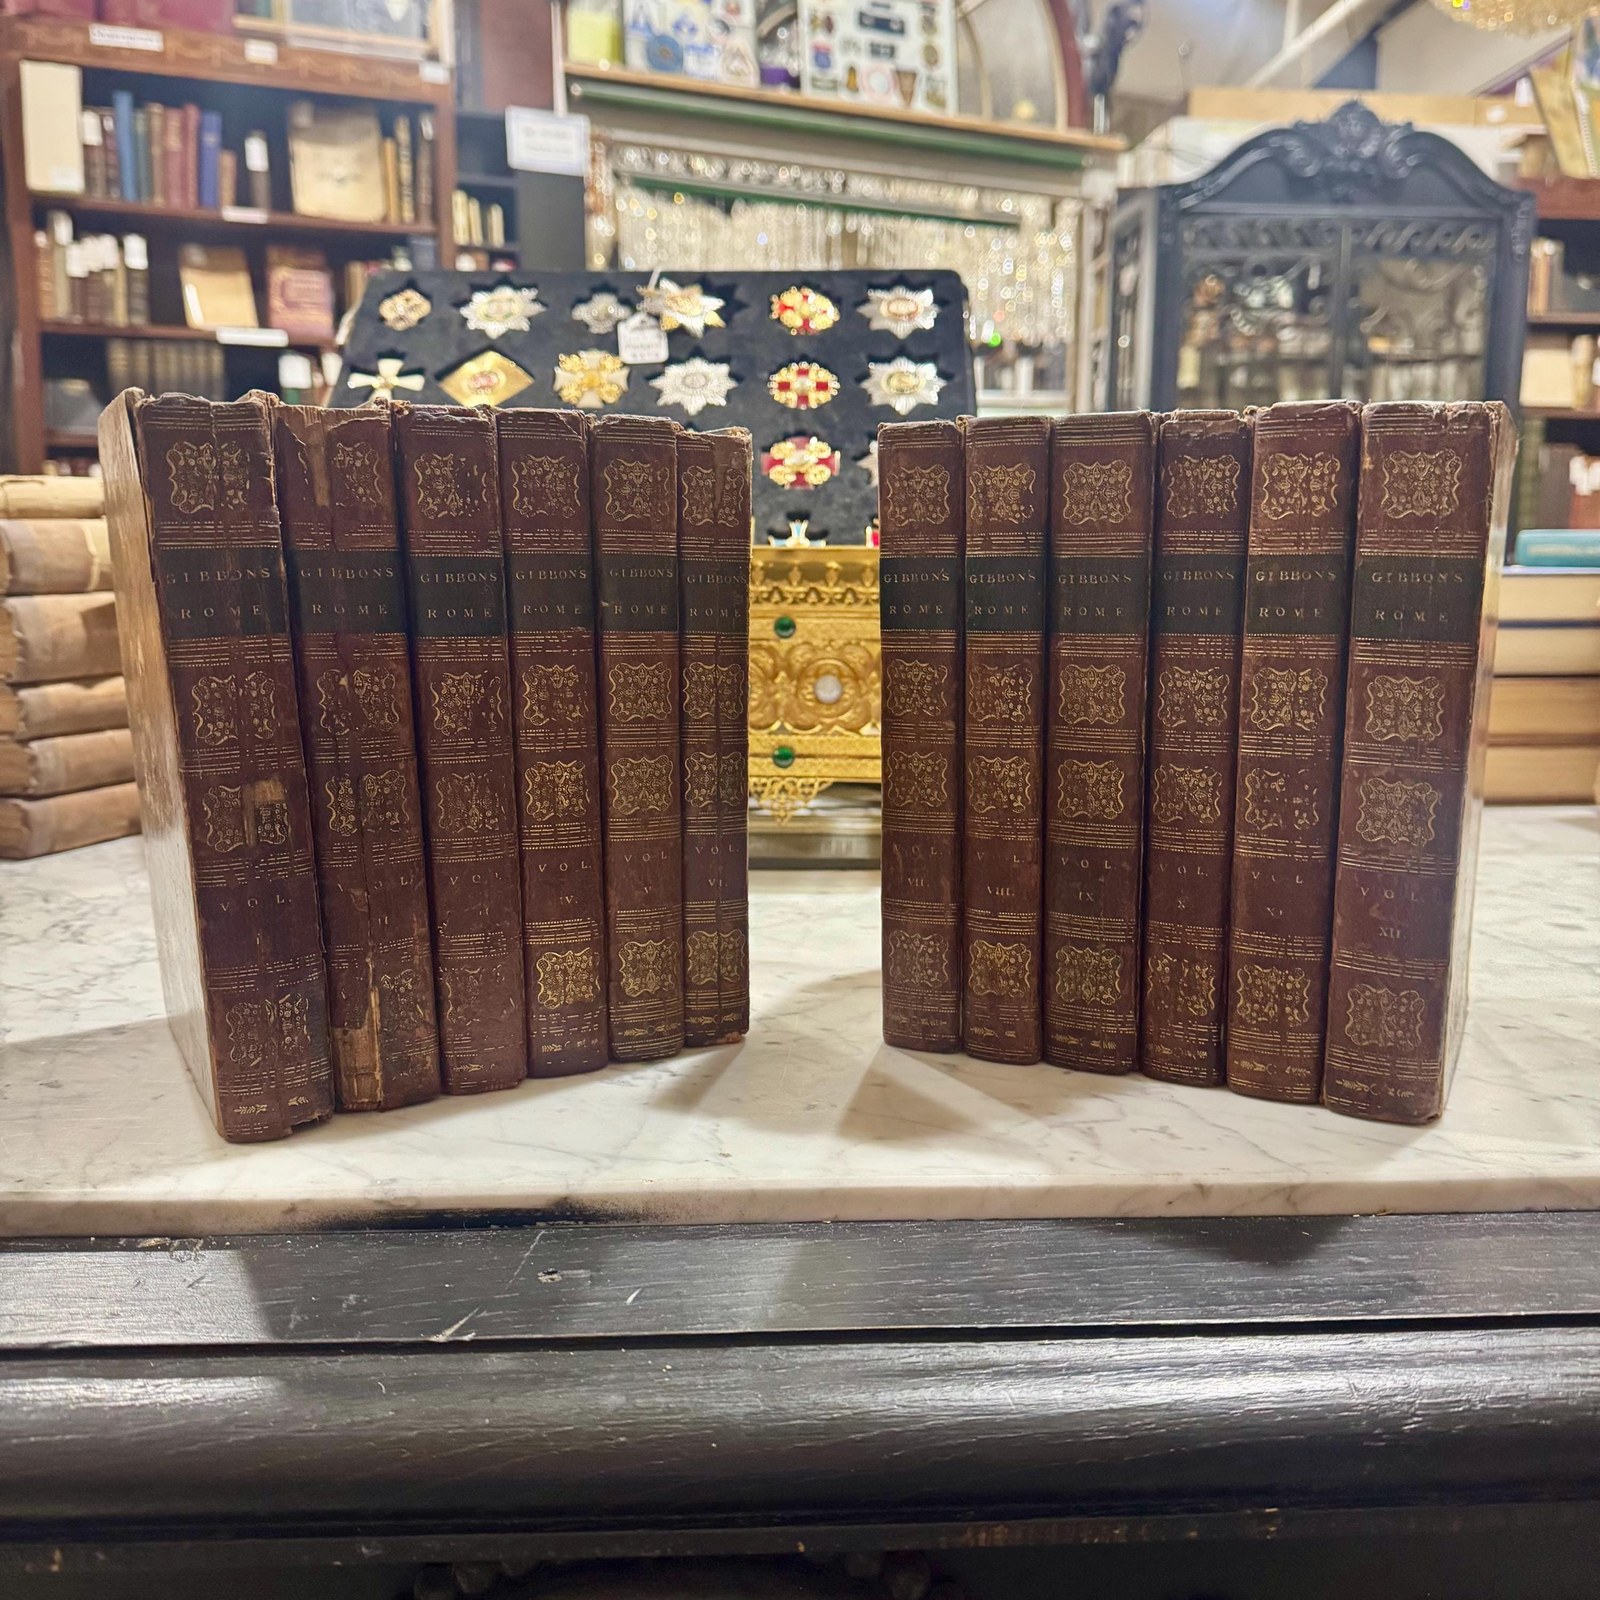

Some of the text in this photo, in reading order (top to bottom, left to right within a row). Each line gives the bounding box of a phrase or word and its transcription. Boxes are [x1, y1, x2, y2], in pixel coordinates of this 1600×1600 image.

[180, 604, 263, 620] ROME
[312, 603, 388, 616] ROME
[427, 607, 493, 619] ROME
[613, 603, 669, 615] ROME
[688, 607, 742, 618] ROME
[888, 604, 944, 616] ROME
[973, 604, 1029, 616] ROME
[1062, 605, 1124, 617] ROME
[1166, 605, 1224, 617] ROME
[1258, 606, 1321, 618] ROME
[1374, 608, 1449, 624] ROME
